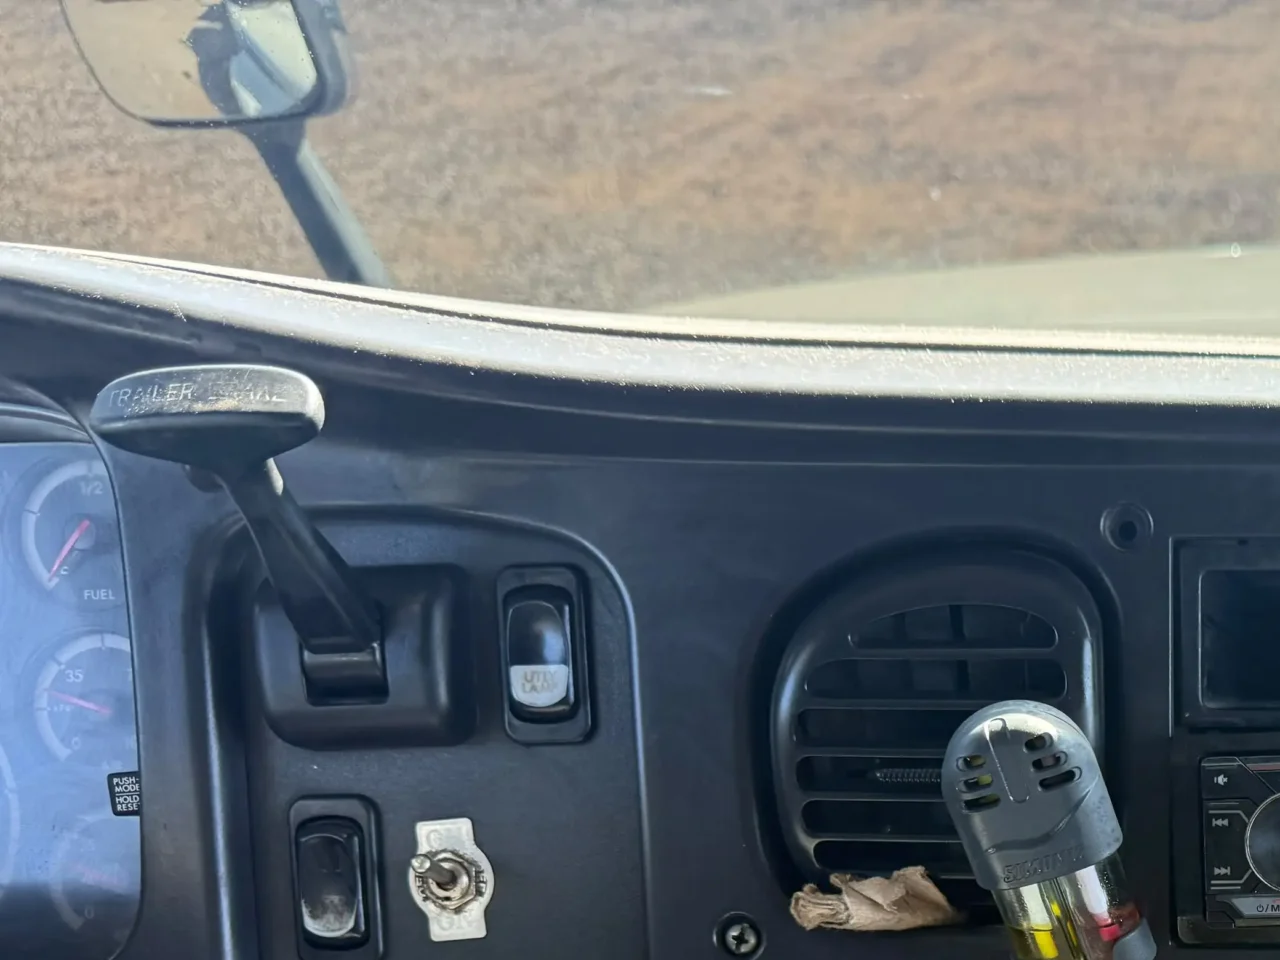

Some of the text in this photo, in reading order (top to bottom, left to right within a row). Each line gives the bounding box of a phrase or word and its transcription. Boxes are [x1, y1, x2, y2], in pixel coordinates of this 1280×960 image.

[84, 589, 115, 600] FUEL
[64, 669, 84, 682] 35
[115, 784, 140, 792] MODE
[115, 795, 140, 803] HOLD
